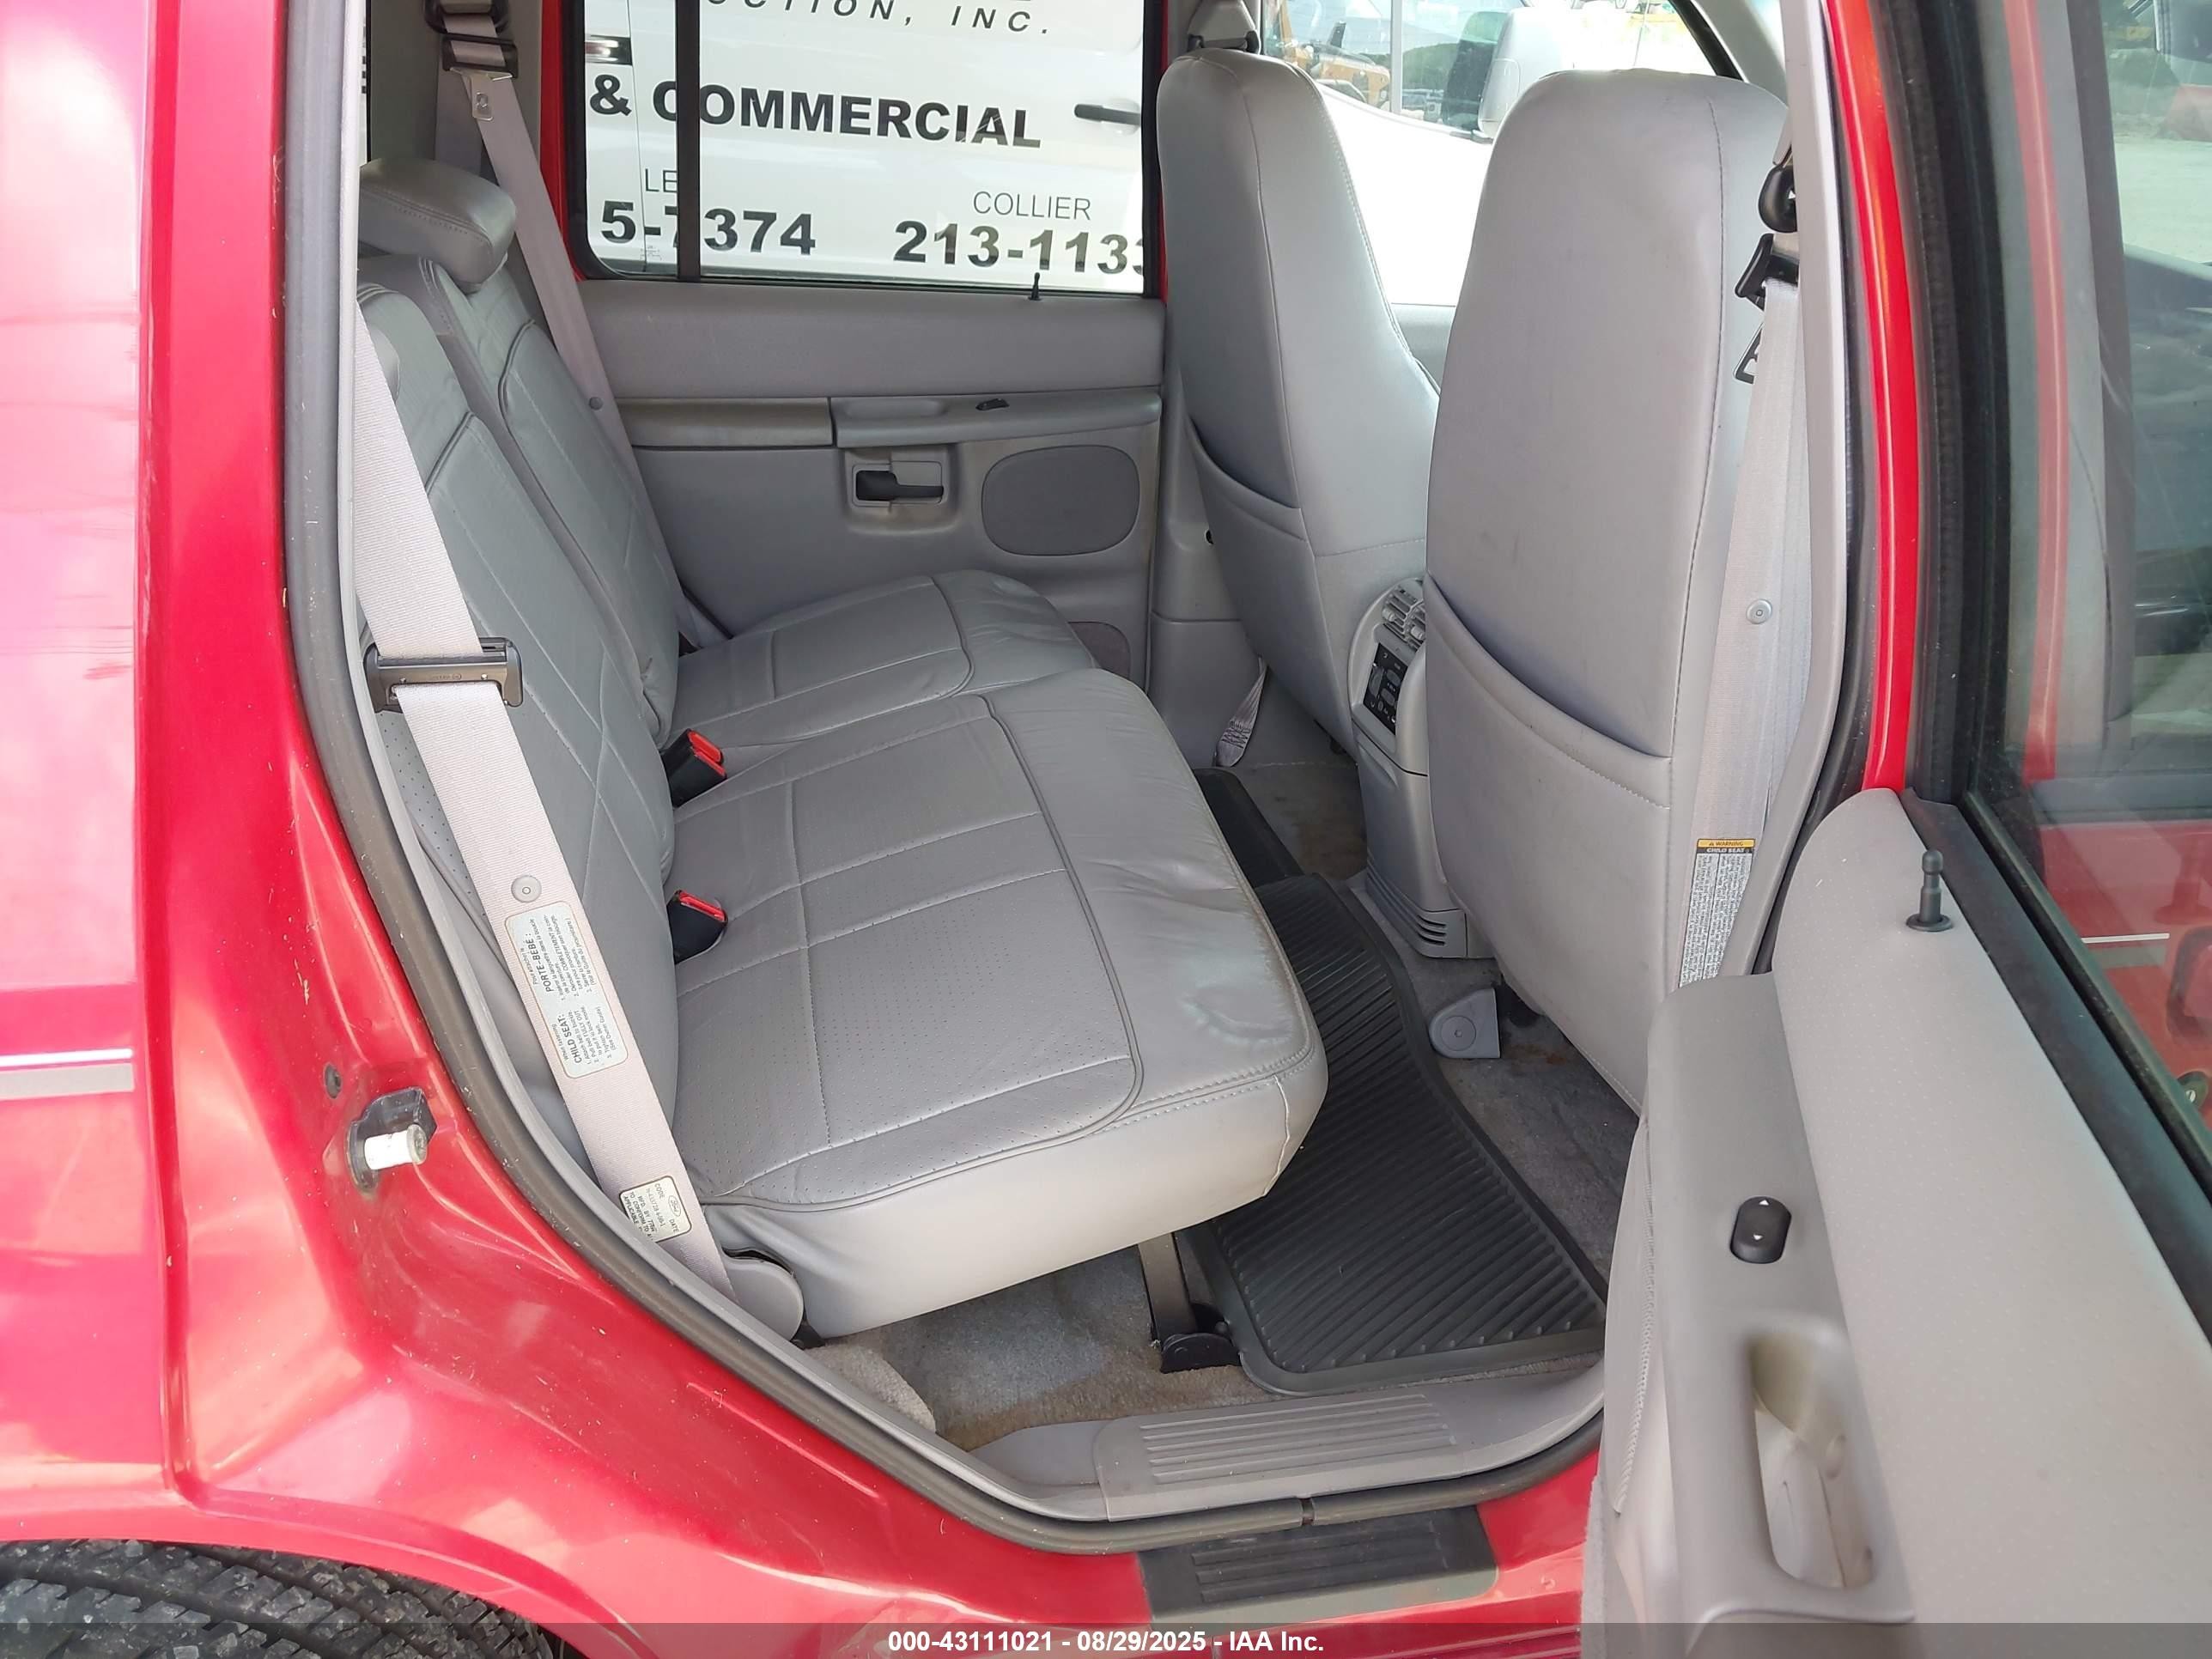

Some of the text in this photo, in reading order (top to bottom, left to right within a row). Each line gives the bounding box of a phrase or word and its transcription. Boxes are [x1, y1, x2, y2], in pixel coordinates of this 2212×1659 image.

[951, 6, 1048, 34] INC.
[589, 74, 1042, 149] & COMMERCIAL
[973, 191, 1091, 221] COLLIER
[893, 220, 1144, 276] 213-113
[557, 1014, 582, 1063] CHILD SEAT:
